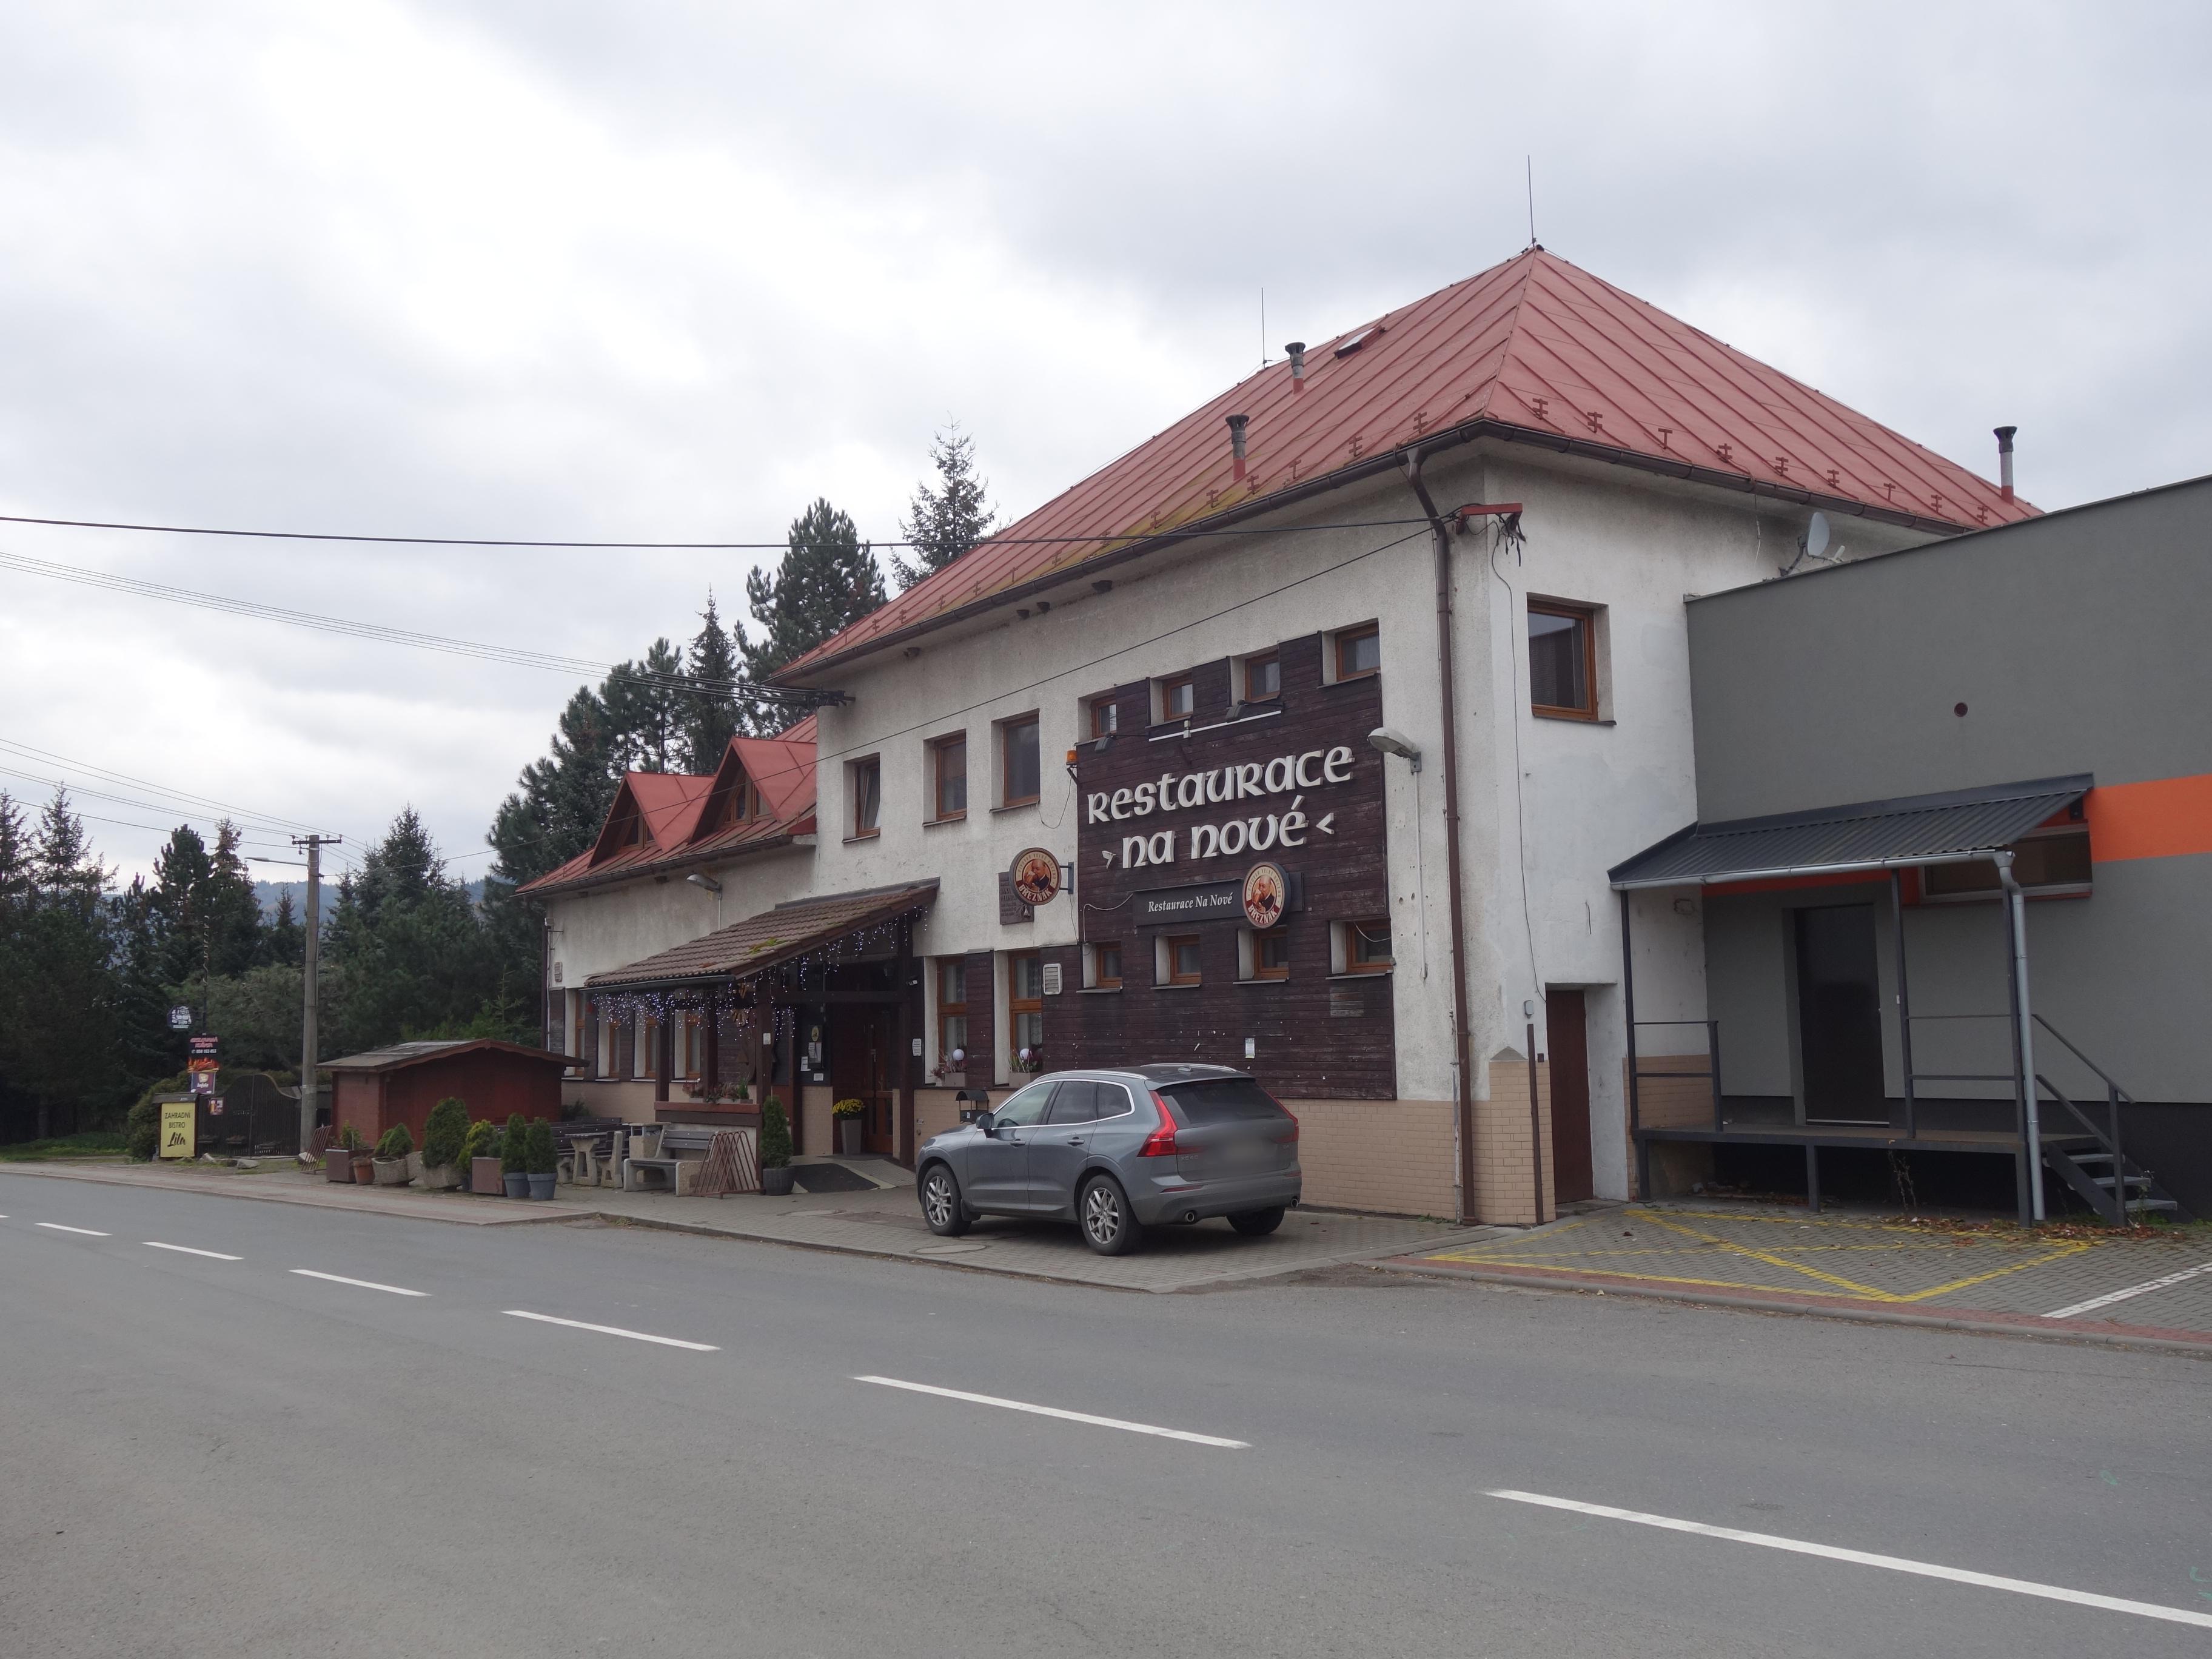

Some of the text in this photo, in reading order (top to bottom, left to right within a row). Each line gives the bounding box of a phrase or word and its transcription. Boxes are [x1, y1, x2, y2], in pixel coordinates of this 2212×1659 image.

[1148, 892, 1233, 912] Restaurace Na Nové
[167, 1131, 186, 1147] Lila
